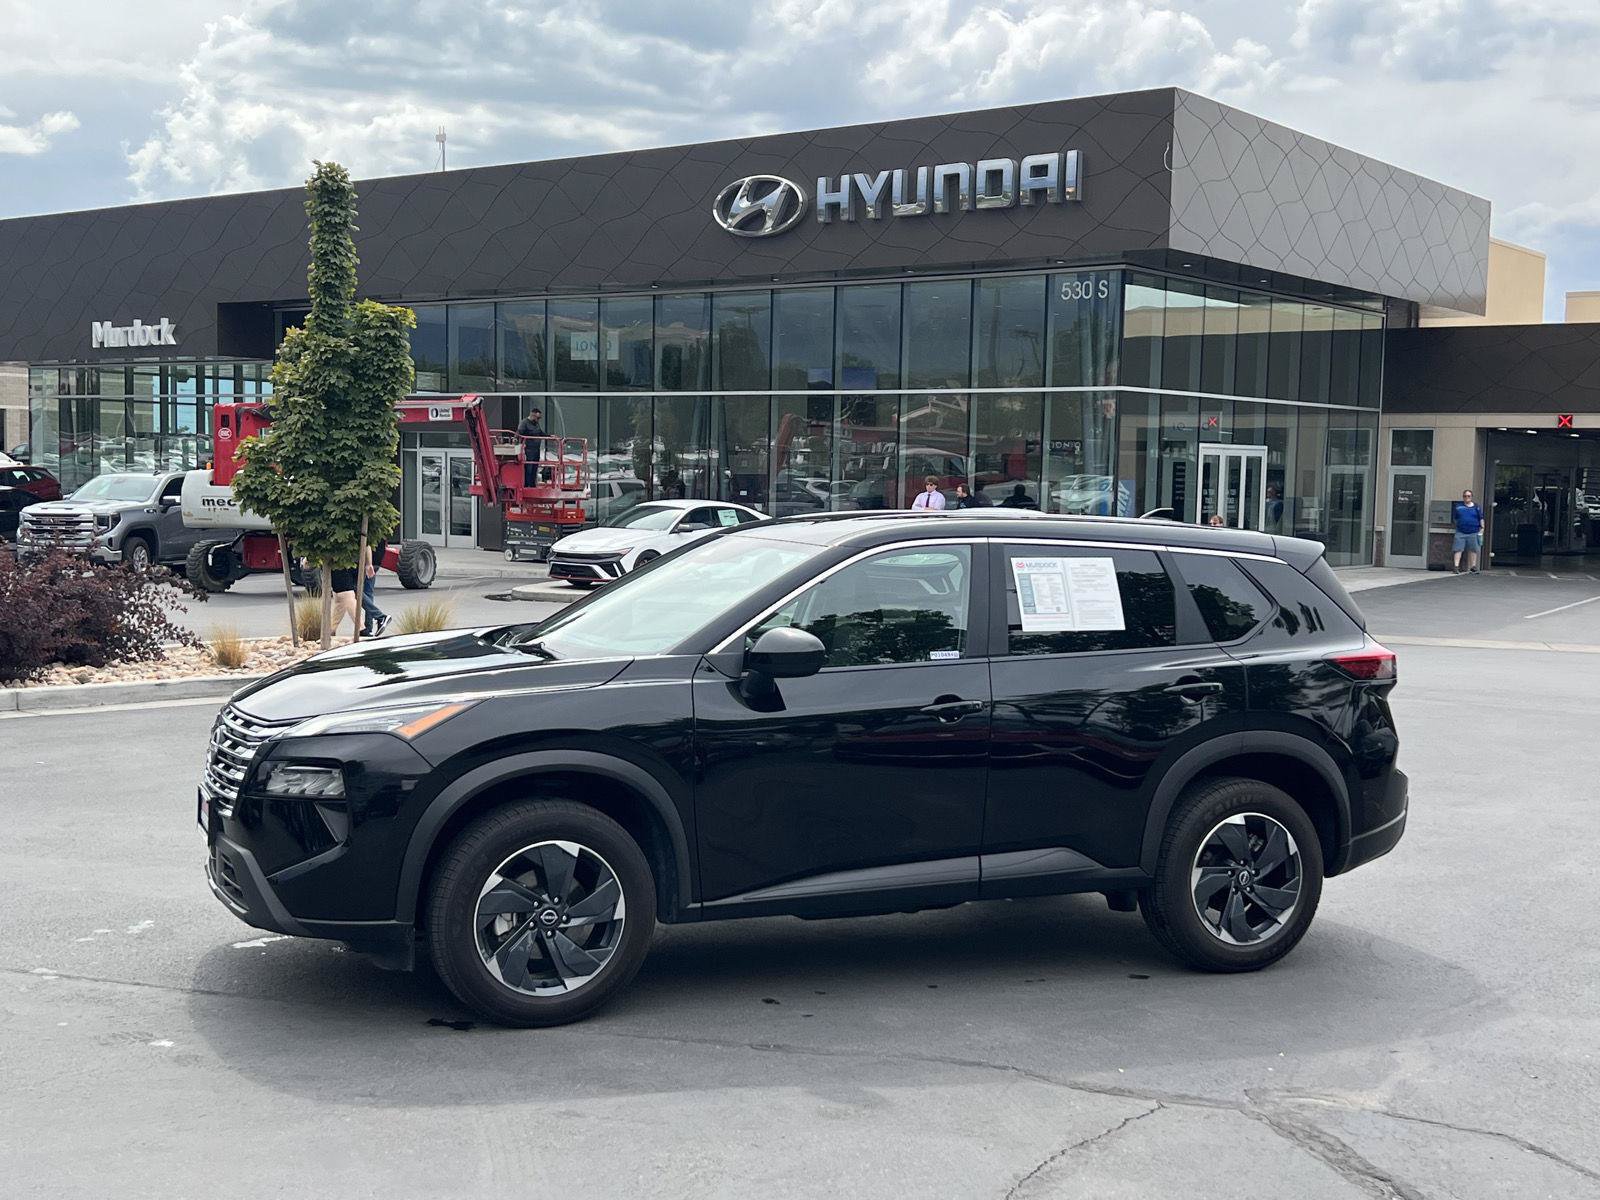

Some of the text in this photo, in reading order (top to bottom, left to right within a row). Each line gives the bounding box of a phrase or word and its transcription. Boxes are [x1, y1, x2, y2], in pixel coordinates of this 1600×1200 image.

[816, 149, 1084, 224] HYUNDAI
[1061, 280, 1108, 300] 530 S
[91, 317, 176, 348] Murdock
